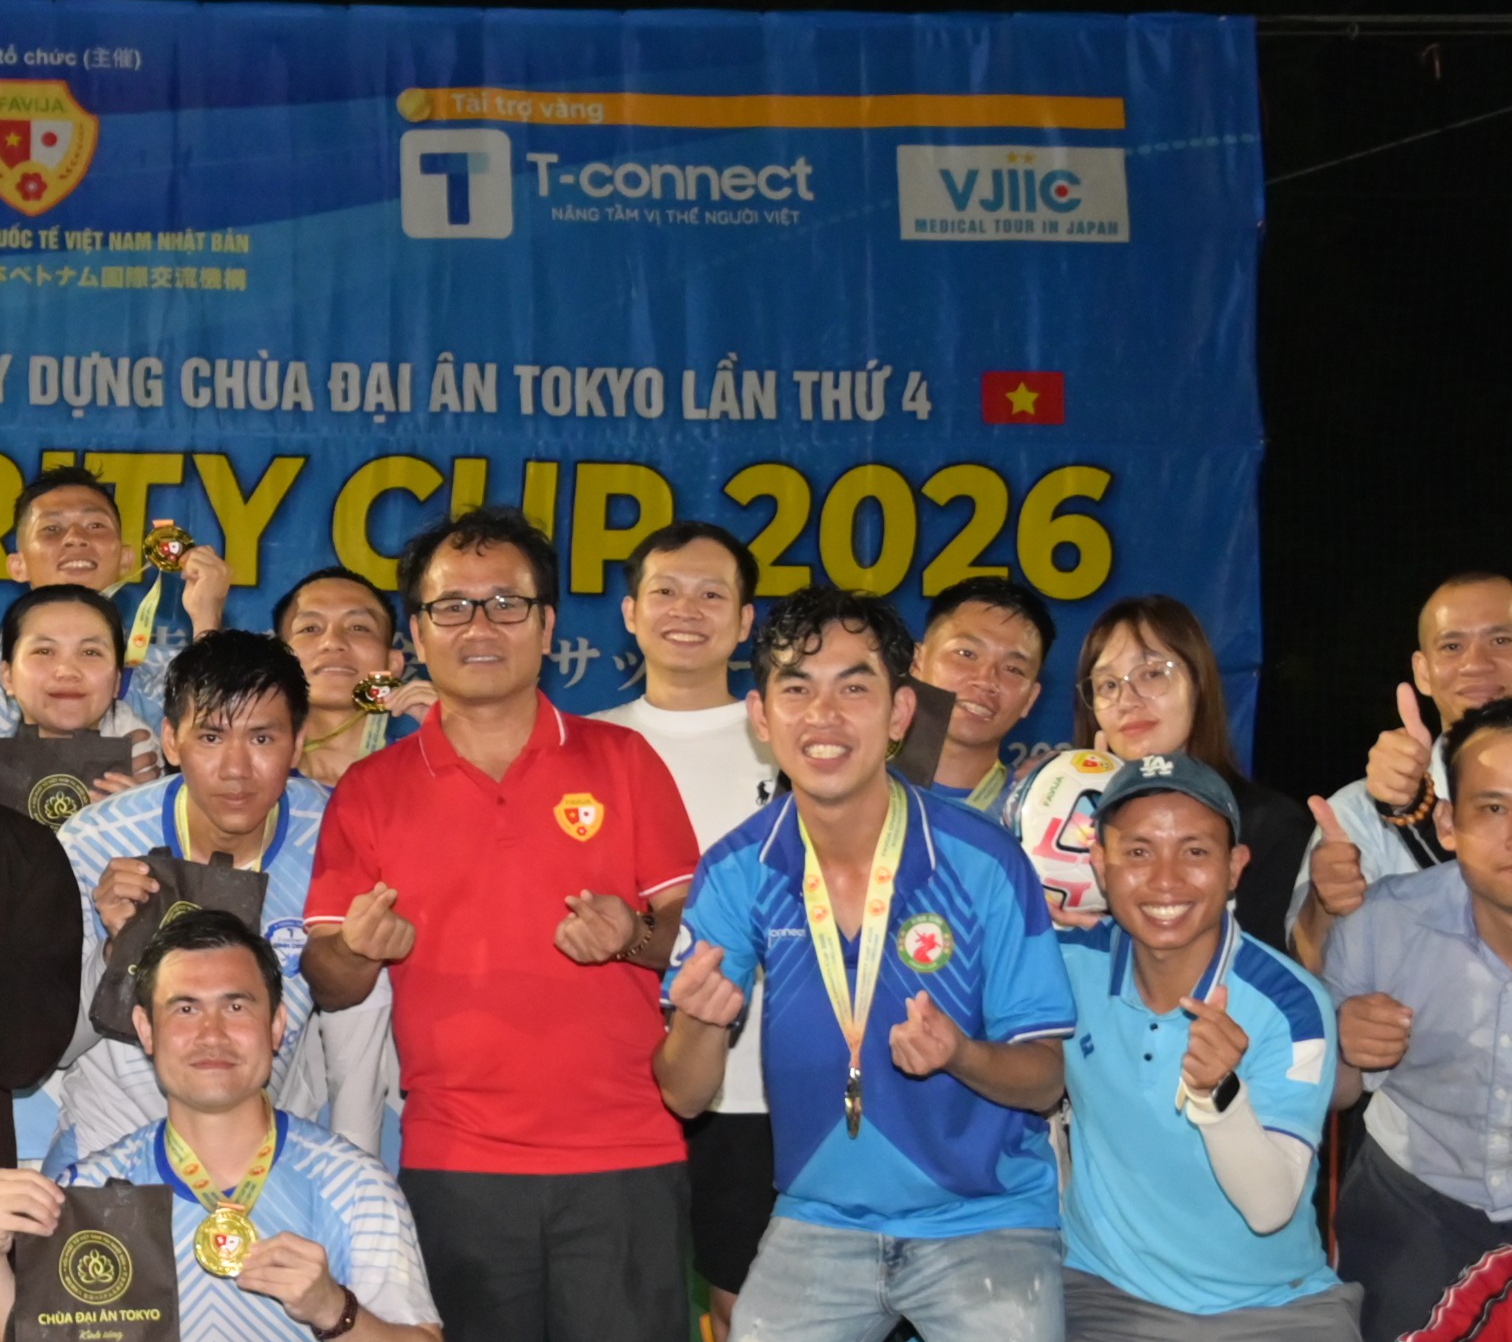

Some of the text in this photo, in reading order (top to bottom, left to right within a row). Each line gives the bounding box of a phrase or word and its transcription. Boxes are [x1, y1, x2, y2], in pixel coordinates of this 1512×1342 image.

[494, 95, 533, 120] trợ
[540, 100, 606, 124] vàng
[525, 152, 816, 202] T-connect
[938, 168, 1083, 213] VJIIC
[108, 231, 152, 251] NAM
[914, 218, 1120, 236] MEDICAL TOUR IN JAPAN
[28, 351, 165, 419] DỰNG
[179, 349, 314, 413] CHÙA
[328, 359, 412, 425] ĐẠI
[427, 351, 499, 414] ÂN
[513, 363, 666, 419] TOKYO
[681, 351, 777, 421] LẦN
[793, 361, 894, 422] THỨ
[901, 369, 933, 422] 4
[721, 461, 1116, 602] 2026
[37, 1311, 73, 1325] CHÙA
[98, 1308, 118, 1322] ÂN
[119, 1309, 161, 1321] TOKYO
